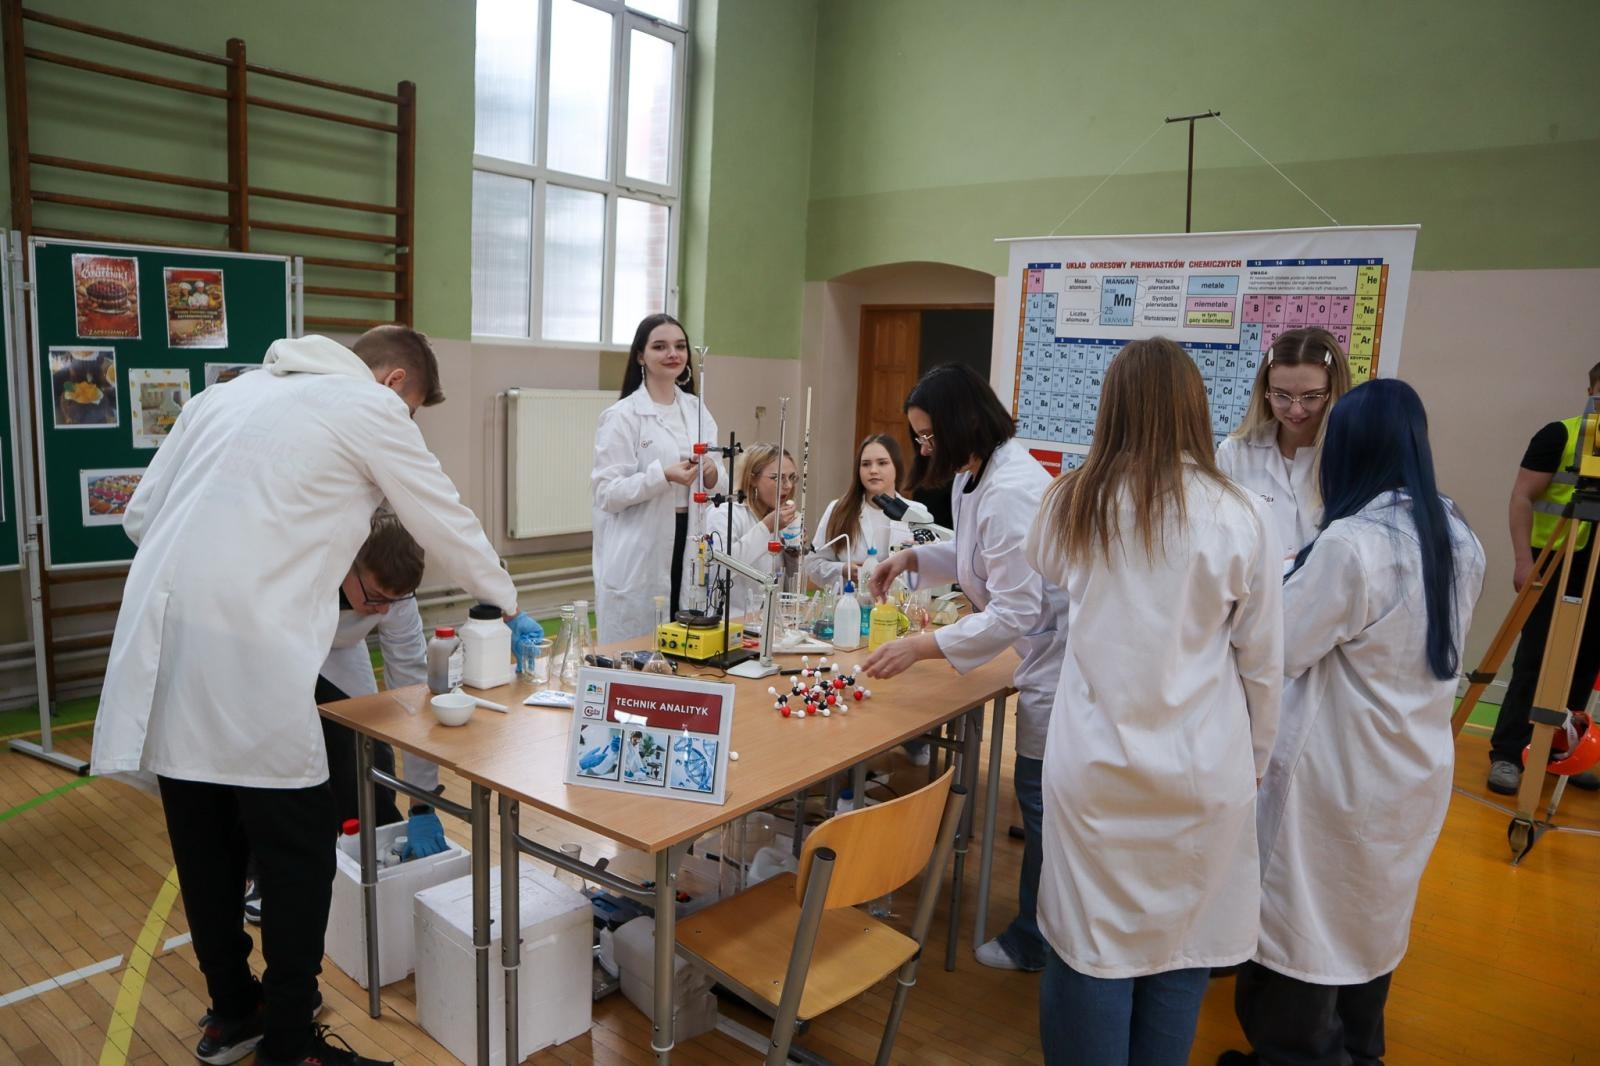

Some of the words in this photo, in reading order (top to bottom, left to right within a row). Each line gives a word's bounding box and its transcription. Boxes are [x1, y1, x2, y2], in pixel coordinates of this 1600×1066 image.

[1130, 260, 1185, 269] PIERWIASTKÓW
[1189, 260, 1242, 268] CHEMICZNYCH
[1114, 293, 1132, 307] Mn
[1046, 326, 1054, 335] Mg
[1338, 335, 1346, 343] Cl
[1205, 359, 1214, 367] Cu
[1358, 366, 1367, 374] Kr
[1223, 387, 1232, 395] Cd
[1219, 414, 1229, 424] Hg
[616, 697, 657, 710] TECHNIK
[660, 704, 709, 716] ANALITYK
